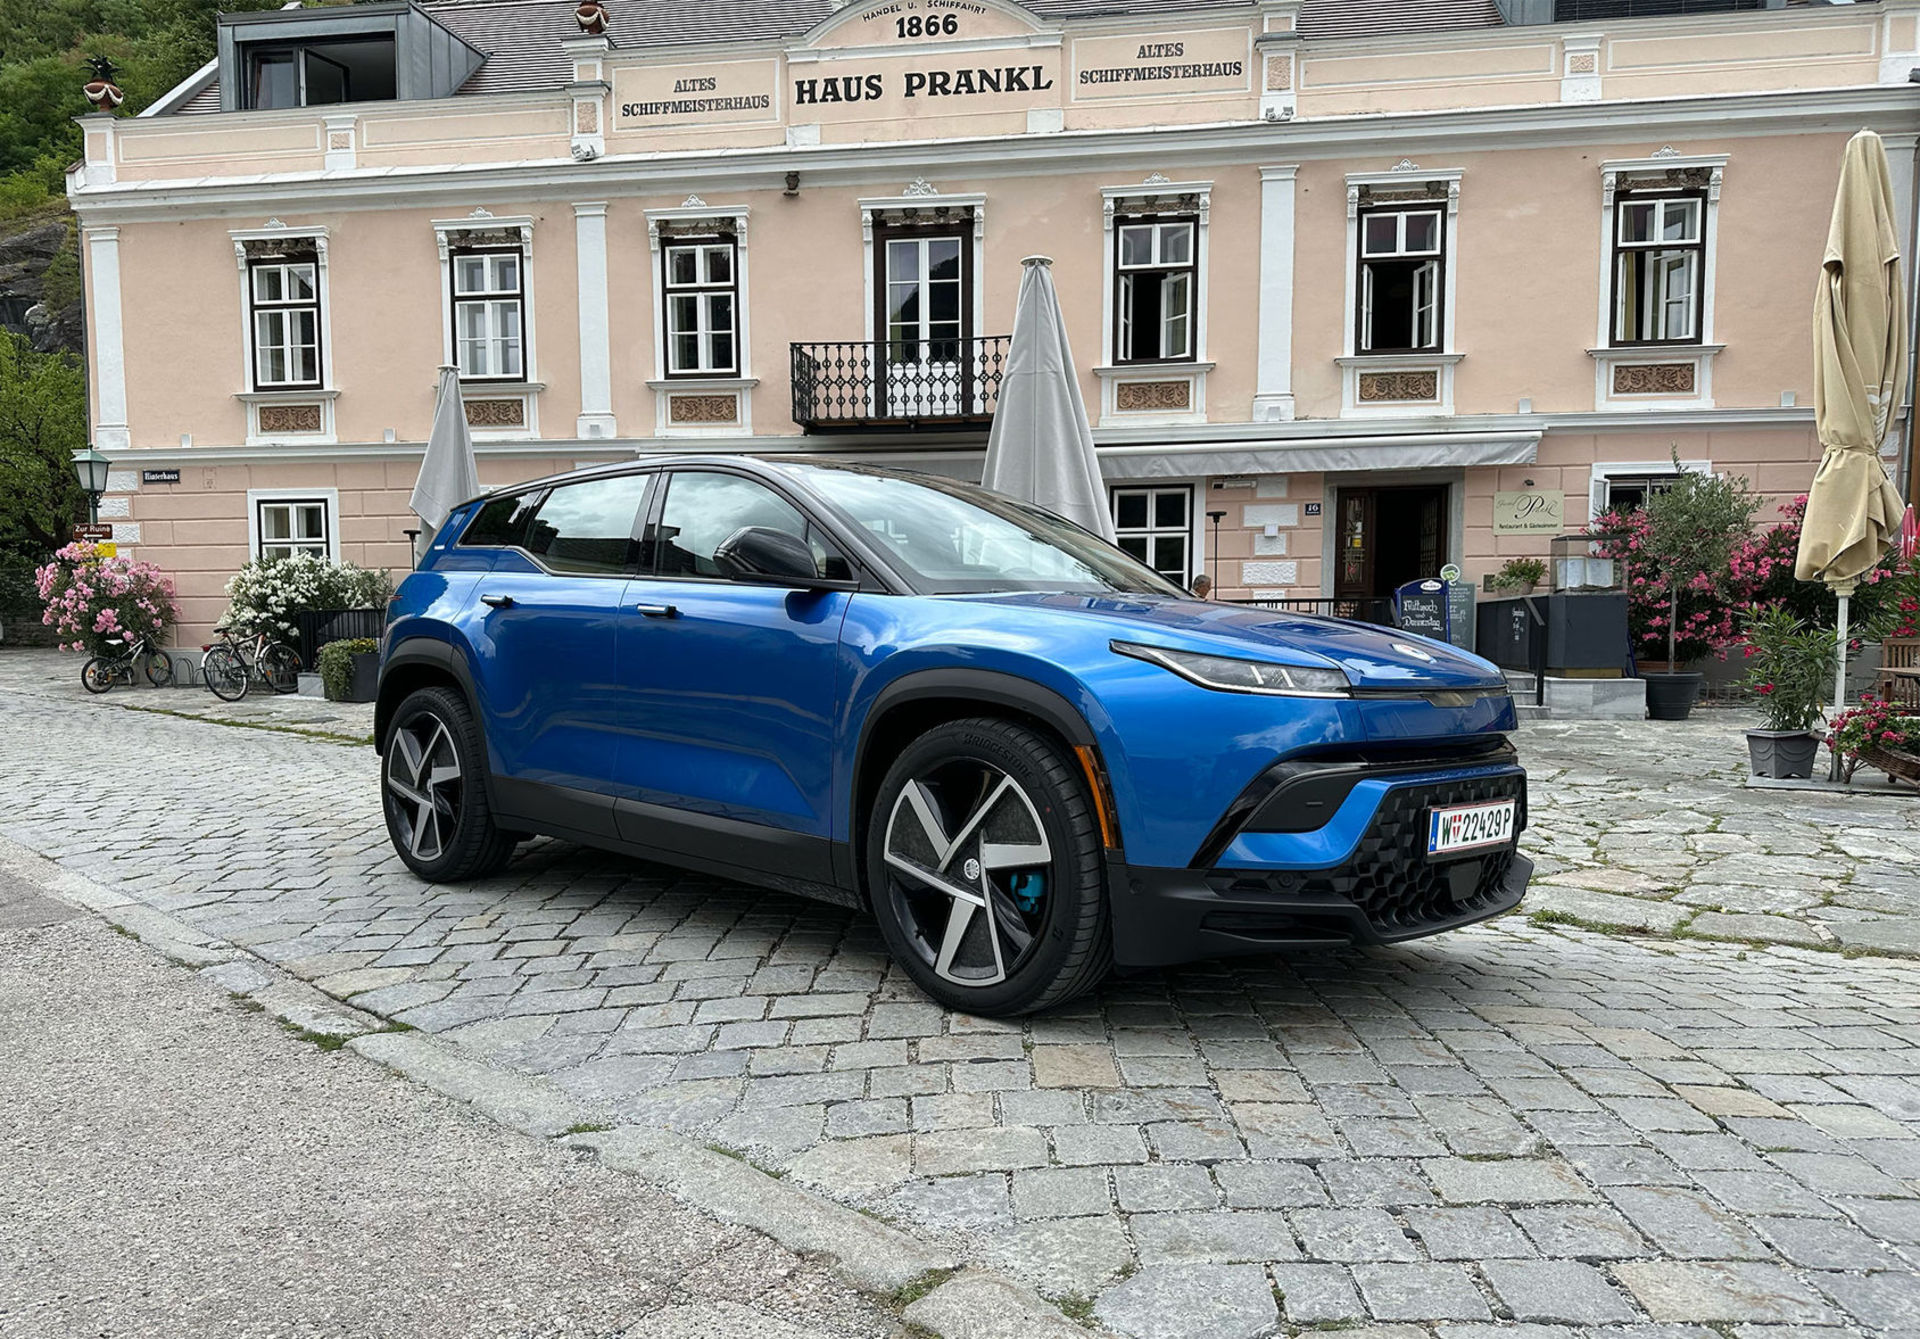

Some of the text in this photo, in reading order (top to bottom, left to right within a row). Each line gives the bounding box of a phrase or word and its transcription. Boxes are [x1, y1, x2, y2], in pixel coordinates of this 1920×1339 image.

[863, 0, 987, 22] HANDEL U. SCHIFFAHRT
[895, 13, 959, 38] 1866
[1136, 42, 1184, 59] ALTES
[795, 65, 1054, 104] HAUS PRANKL
[1079, 61, 1243, 85] SCHIFFMEISTERHAUS
[673, 77, 717, 93] ALTES
[621, 94, 770, 117] SCHIFFMEISTERHAUS
[1442, 816, 1453, 845] W
